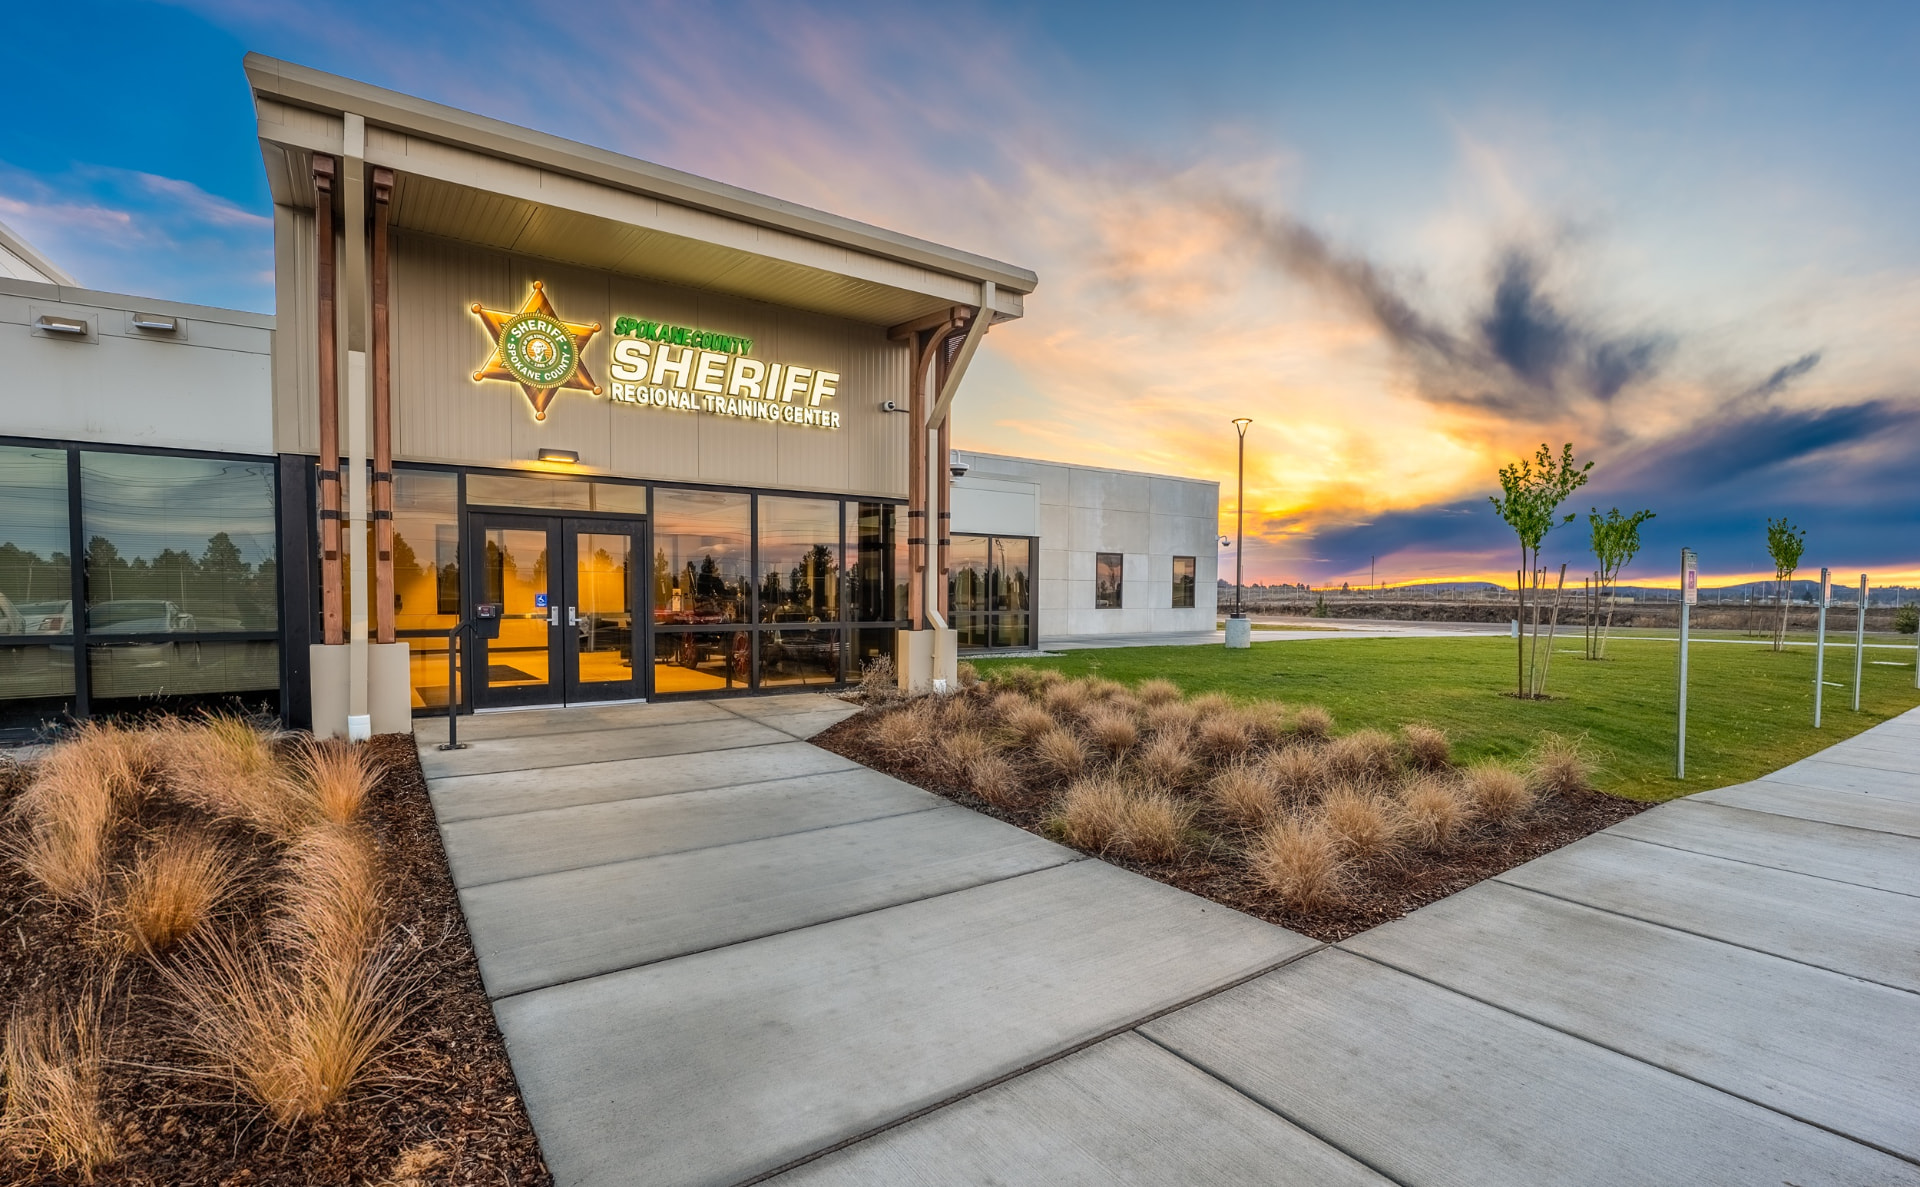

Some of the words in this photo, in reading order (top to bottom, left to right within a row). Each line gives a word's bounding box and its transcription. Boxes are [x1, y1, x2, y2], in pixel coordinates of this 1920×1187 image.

[511, 320, 567, 343] SHERIFF
[614, 317, 692, 346] SPOKANE
[692, 331, 753, 355] COUNTY
[507, 343, 541, 381] SPOKANE
[544, 352, 571, 381] COUNTY
[611, 339, 840, 407] SHERIFF
[611, 383, 700, 411] REGIONAL
[704, 395, 780, 421] TRAINING
[781, 405, 840, 428] CENTER
